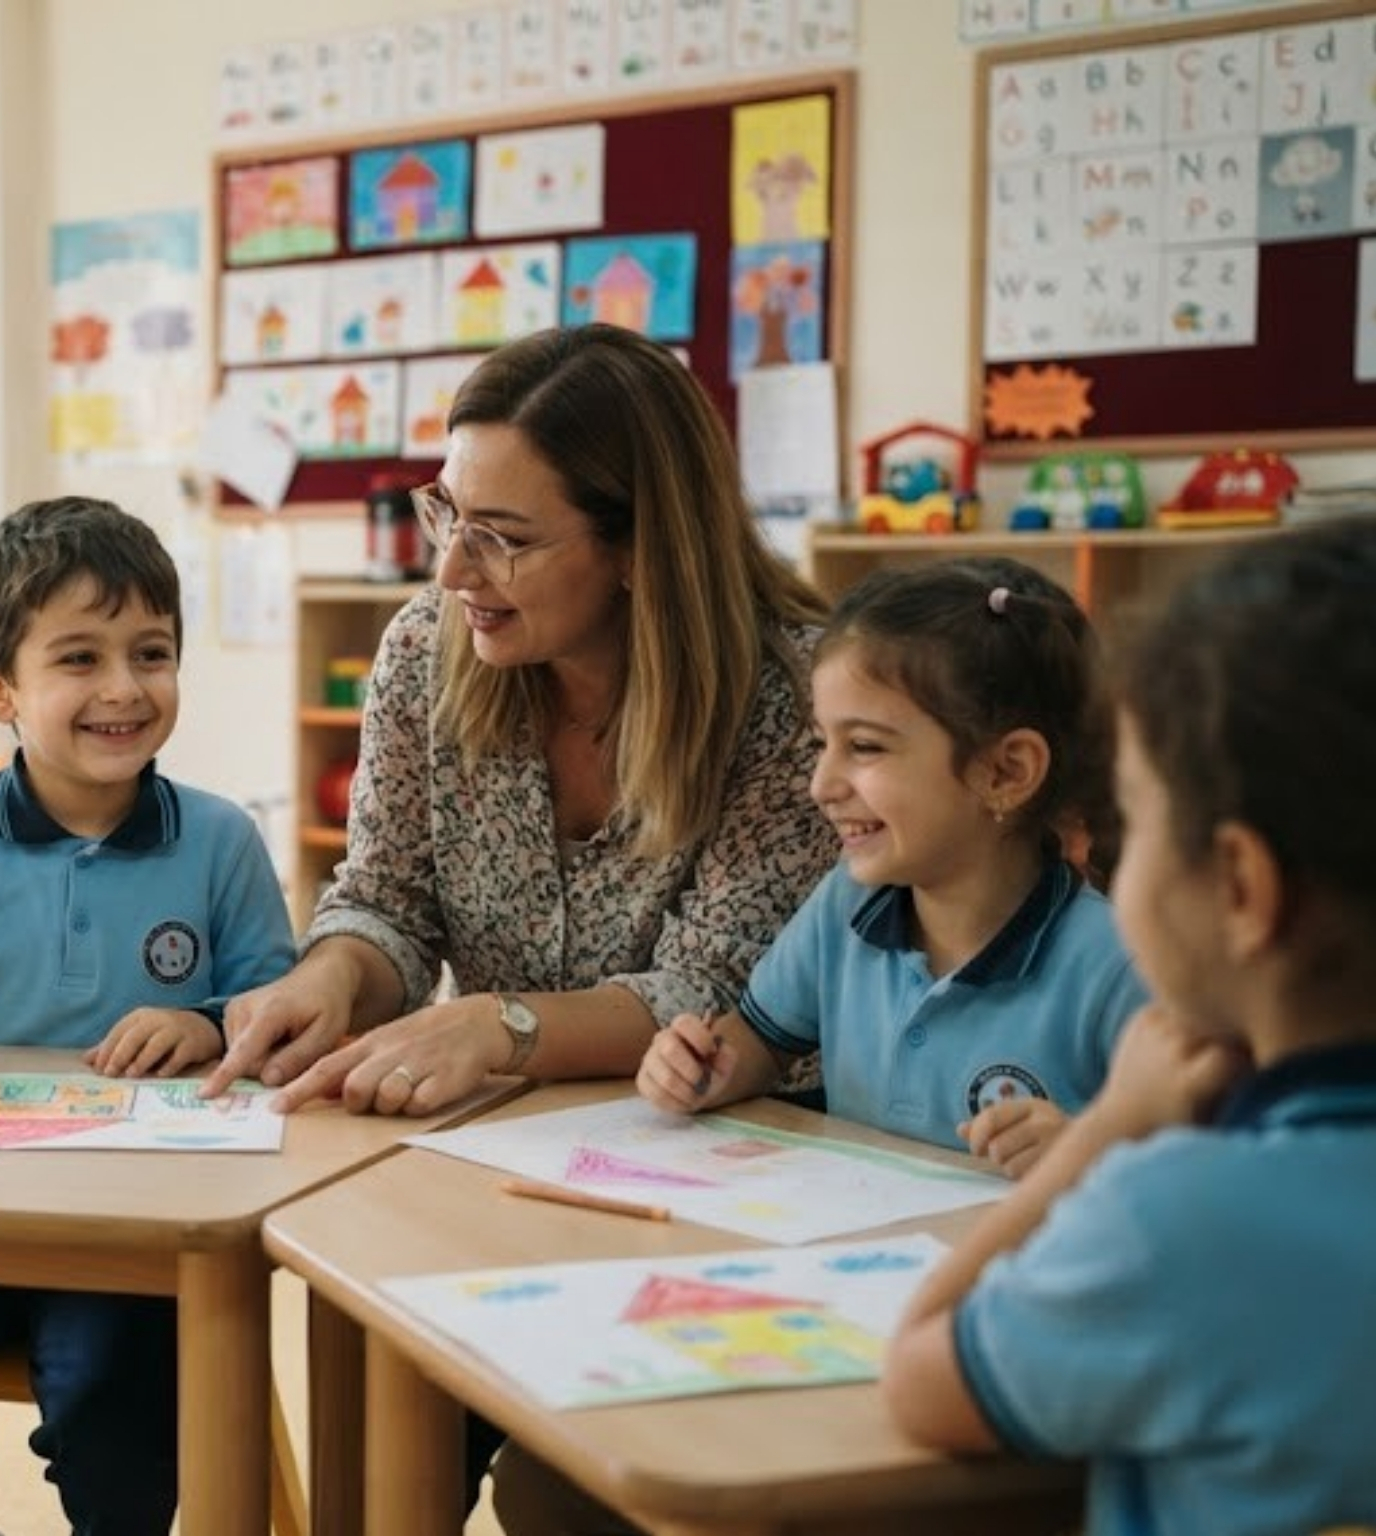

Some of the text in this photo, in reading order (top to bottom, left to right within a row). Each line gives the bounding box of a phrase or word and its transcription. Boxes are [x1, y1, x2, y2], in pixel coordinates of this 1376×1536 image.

[1177, 47, 1205, 82] C
[1274, 34, 1296, 69] E
[1313, 28, 1336, 64] d
[1000, 72, 1022, 101] A
[1083, 163, 1115, 191] M
[1177, 152, 1206, 184] N
